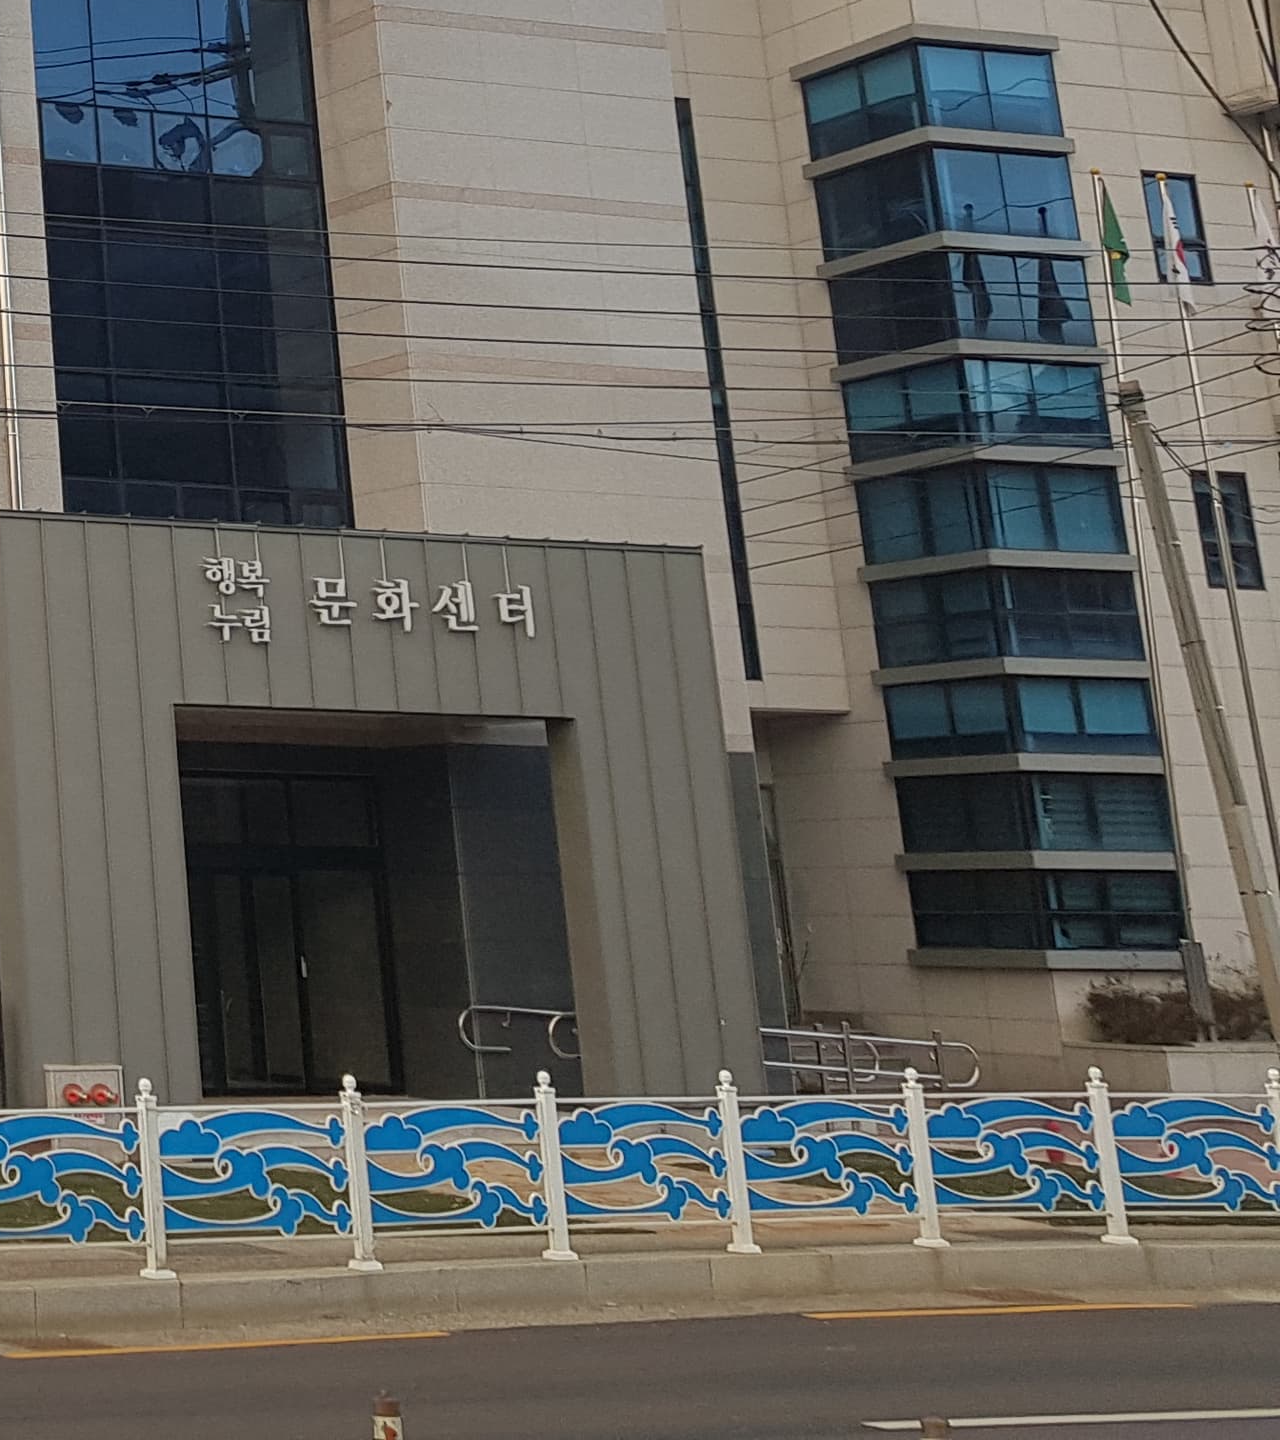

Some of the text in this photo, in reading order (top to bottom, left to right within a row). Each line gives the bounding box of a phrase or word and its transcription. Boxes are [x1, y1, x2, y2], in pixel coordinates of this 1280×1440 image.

[199, 556, 271, 598] 행복
[205, 603, 271, 643] 누림
[309, 576, 536, 638] 문화센터
